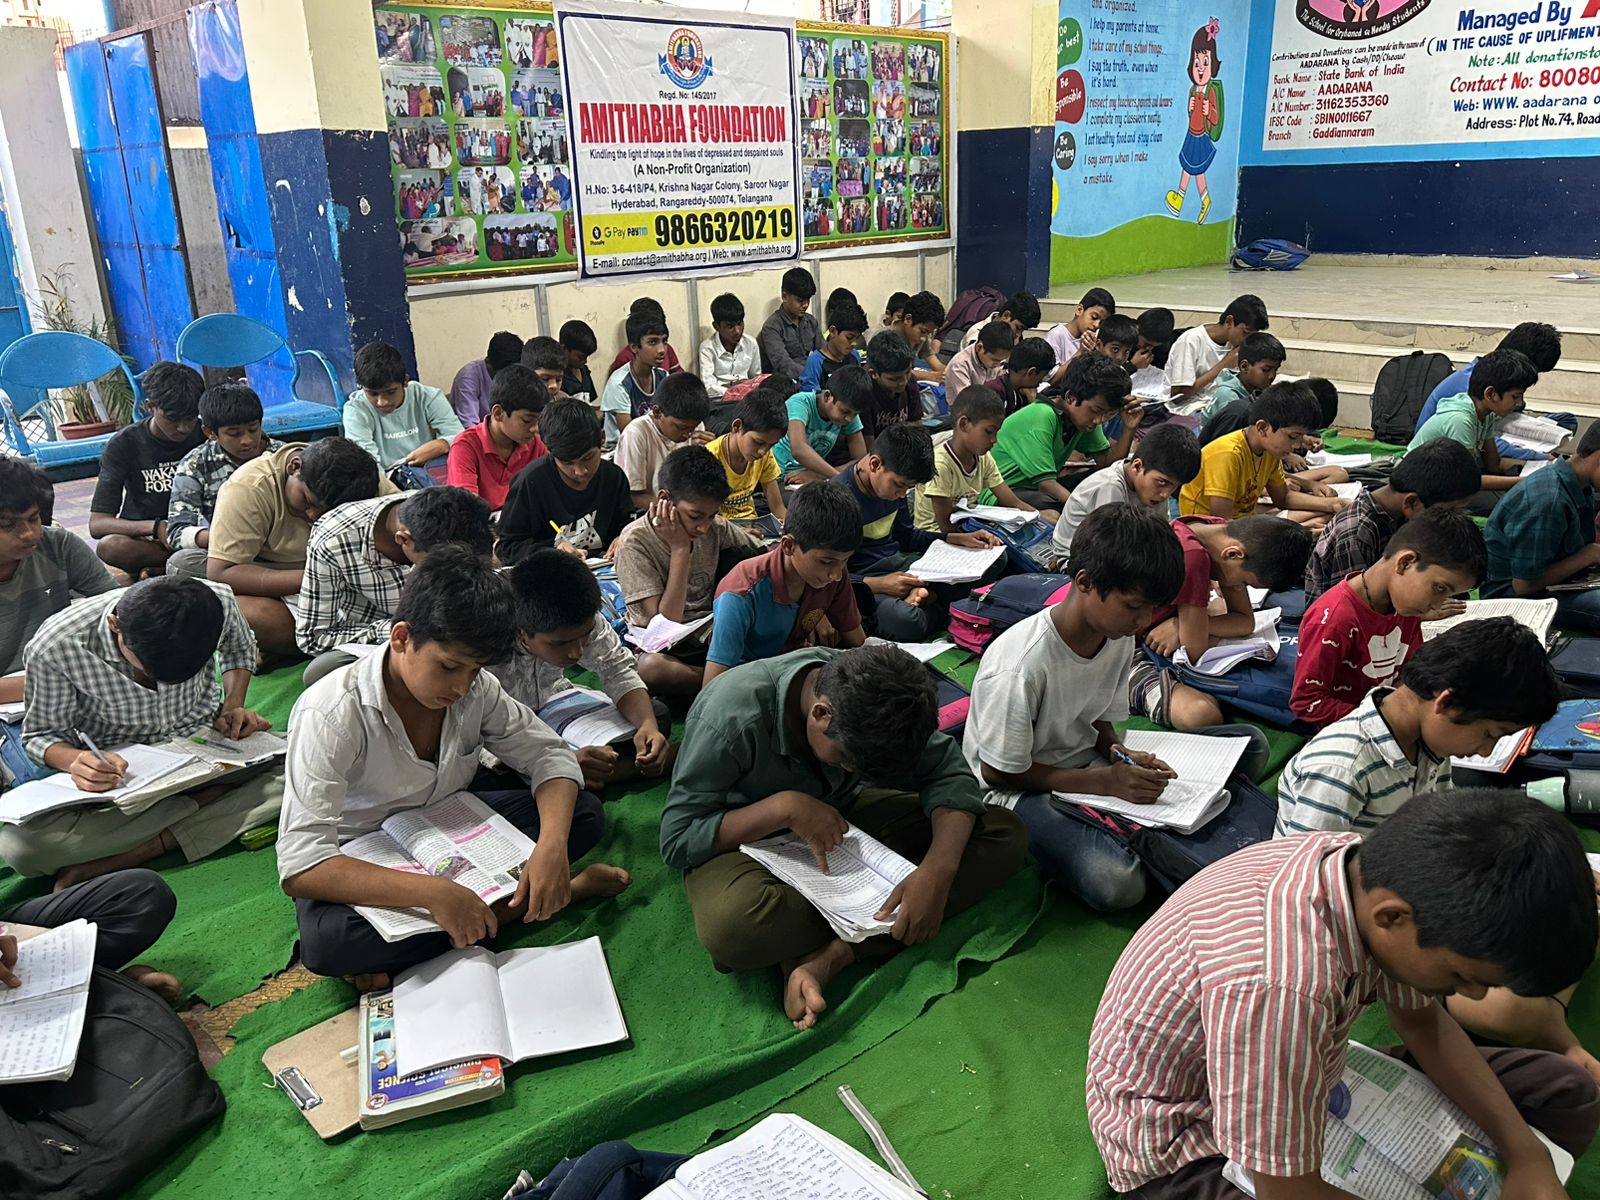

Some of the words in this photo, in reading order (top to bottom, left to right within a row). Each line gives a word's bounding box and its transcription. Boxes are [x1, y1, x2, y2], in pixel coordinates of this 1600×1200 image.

[1309, 17, 1326, 32] School
[1326, 24, 1335, 35] for
[1371, 22, 1391, 35] Needy
[1392, 0, 1425, 26] Students
[1457, 2, 1542, 31] Managed
[1546, 0, 1572, 26] By
[1059, 25, 1067, 37] Do
[1093, 17, 1105, 33] help
[1106, 21, 1115, 34] my
[1115, 21, 1137, 36] parents
[1138, 20, 1145, 33] at
[1065, 30, 1080, 48] best
[1453, 36, 1475, 50] THE
[1478, 33, 1514, 48] CAUSE
[1518, 31, 1533, 44] OF
[1536, 25, 1600, 43] UPLIFMENT
[1272, 51, 1310, 62] Contributions
[1310, 49, 1322, 57] and
[1322, 48, 1353, 57] Donations
[1354, 46, 1367, 54] can
[1367, 44, 1376, 53] be
[1091, 61, 1101, 75] say
[1103, 59, 1112, 72] the
[1300, 58, 1339, 69] AADARANA
[1341, 58, 1350, 67] by
[1274, 74, 1290, 85] Bank
[1293, 73, 1311, 83] Name
[1318, 70, 1340, 81] State
[1344, 67, 1365, 79] Bank
[1369, 67, 1379, 77] of
[1383, 64, 1405, 76] India
[1450, 72, 1508, 93] Contact
[1511, 71, 1534, 90] No:
[1539, 66, 1600, 88] 80080
[1060, 77, 1069, 89] Be
[1286, 87, 1306, 98] Name
[1317, 80, 1373, 96] AADARANA
[659, 91, 677, 100] Regd.
[679, 91, 690, 99] No:
[691, 91, 717, 100] 145/2017
[1316, 94, 1389, 110] 31162353360
[1453, 99, 1479, 112] Web:
[1483, 96, 1519, 110] WWW.
[1523, 95, 1587, 109] aadarana
[579, 103, 688, 143] AMITHABHA
[690, 105, 786, 143] FOUNDATION
[1269, 117, 1284, 127] IFSC
[1286, 116, 1302, 126] Code
[1466, 117, 1516, 130] Address:
[1519, 114, 1539, 127] Plot
[1577, 112, 1600, 125] Road
[1060, 135, 1068, 146] Be
[1137, 132, 1149, 147] stay
[1268, 130, 1291, 141] Branch
[590, 149, 616, 160] Kindling
[617, 149, 627, 159] the
[628, 149, 642, 161] light
[643, 149, 649, 159] of
[650, 149, 665, 161] hope
[665, 149, 671, 158] in
[672, 149, 682, 158] the
[682, 149, 696, 159] lives
[697, 149, 704, 158] of
[704, 149, 732, 160] depressed
[733, 149, 743, 158] and
[744, 148, 769, 159] despaired
[770, 148, 784, 157] souls
[1056, 147, 1075, 161] Caring
[1088, 155, 1097, 168] say
[1098, 155, 1113, 167] sorry
[1115, 152, 1129, 163] when
[634, 164, 645, 178] (A
[647, 163, 693, 175] Non-Profit
[694, 162, 750, 176] Organization)
[585, 184, 609, 195] H.No:
[611, 184, 657, 195] 3-6-418/P4,
[659, 182, 689, 192] Krishna
[691, 181, 714, 193] Nagar
[715, 180, 742, 192] Colony,
[744, 180, 767, 189] Saroor
[769, 179, 789, 190] Nagar
[611, 198, 658, 210] Hyderabad,
[660, 195, 736, 208] Rangareddy-500074,
[738, 194, 772, 206] Telangana
[612, 227, 626, 239] Pay
[655, 208, 793, 247] 9866320219
[593, 258, 620, 269] E-mail:
[621, 252, 707, 266] contact@amithabha.org
[712, 249, 729, 259] Web:
[730, 244, 792, 258] www.amithabha.org
